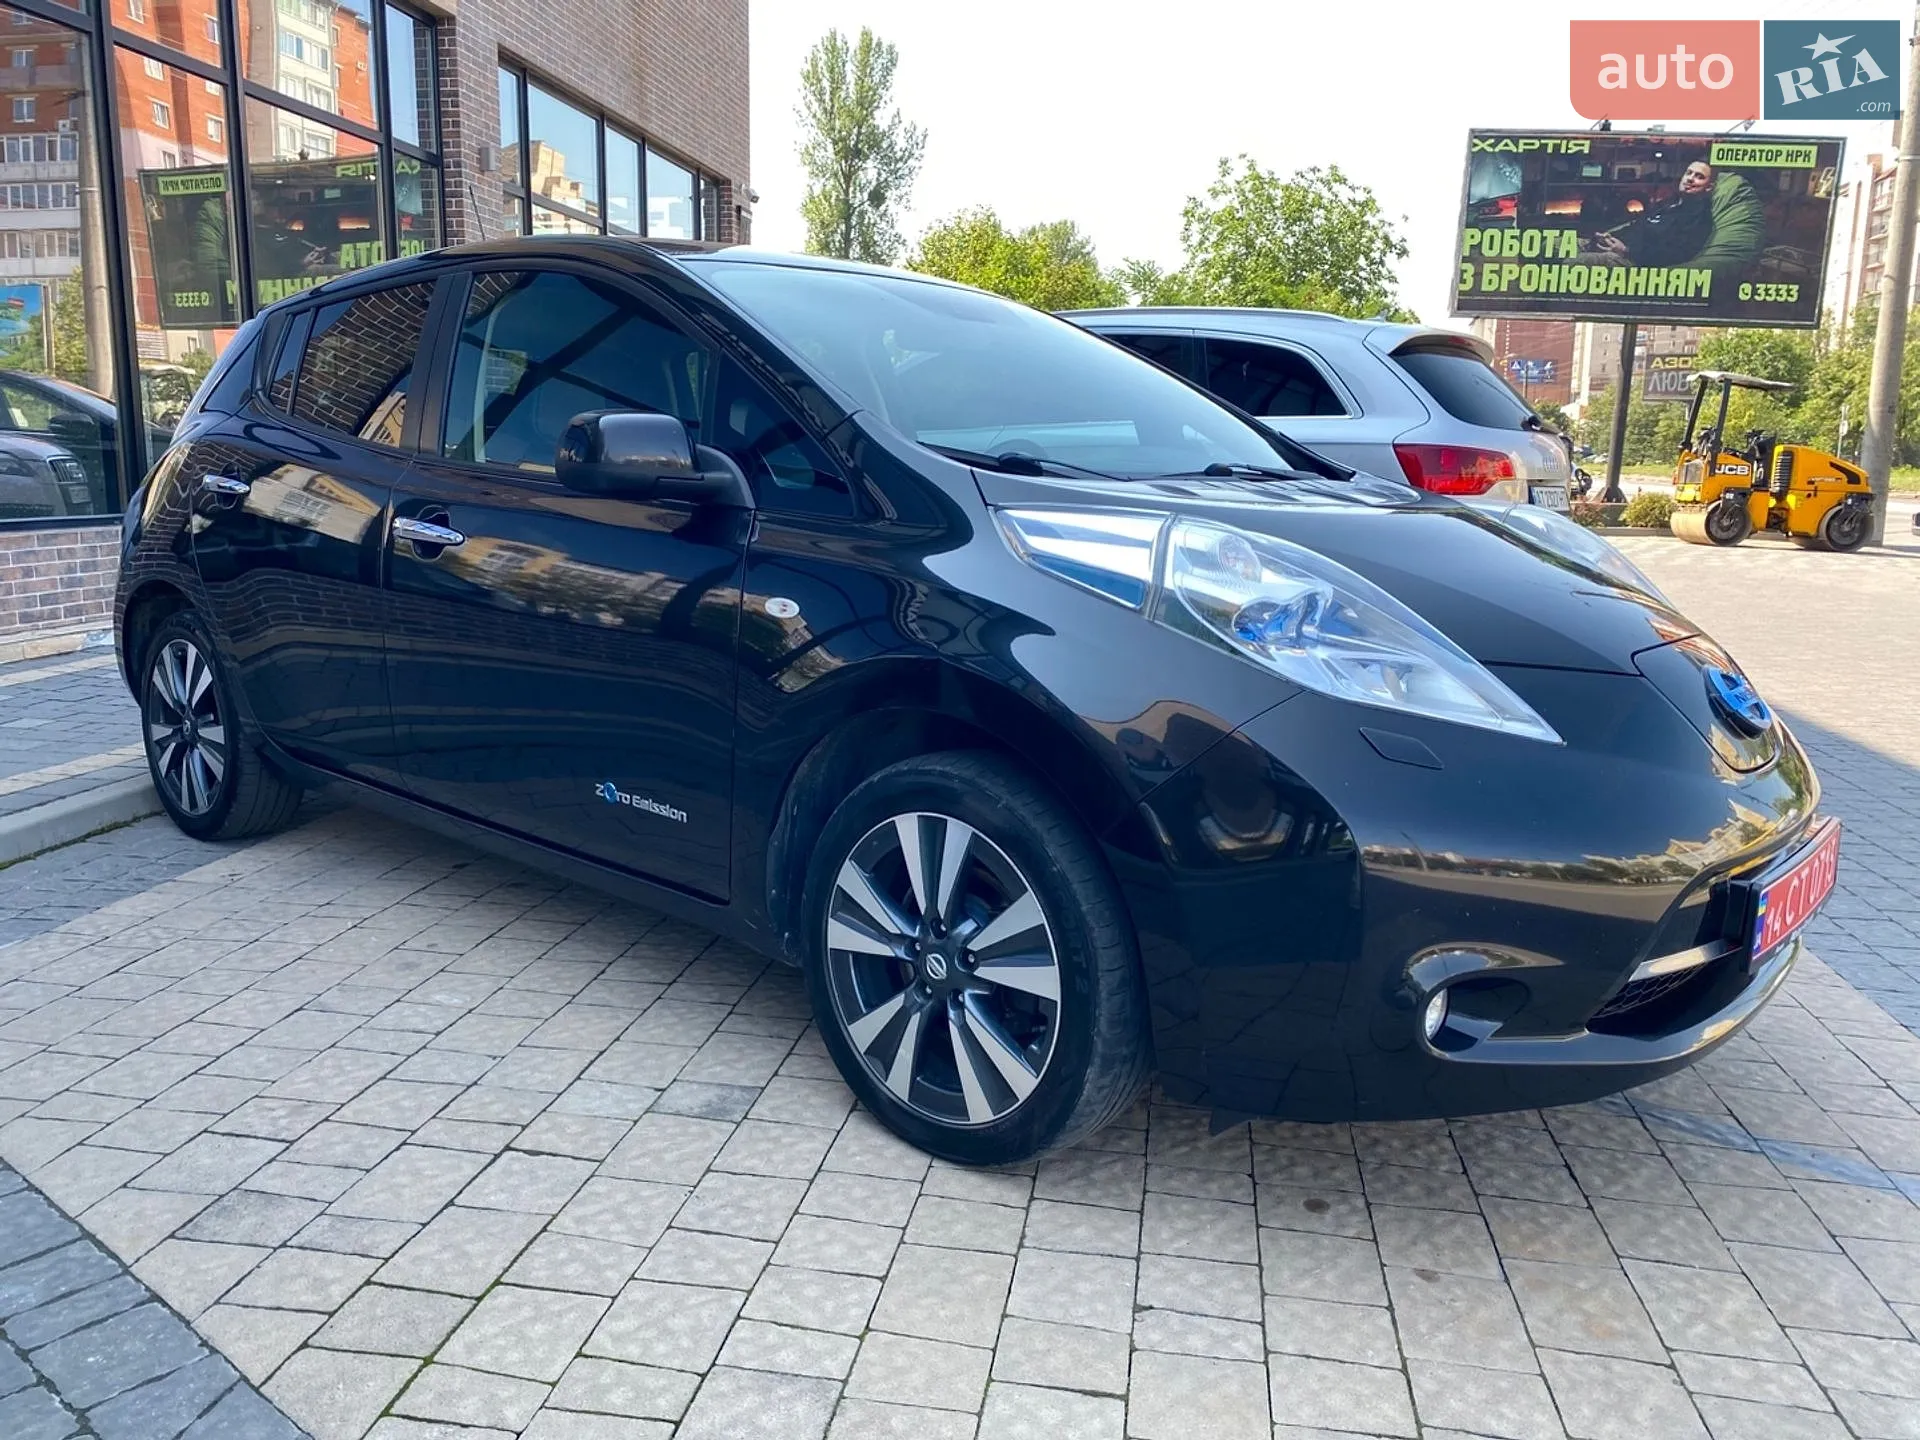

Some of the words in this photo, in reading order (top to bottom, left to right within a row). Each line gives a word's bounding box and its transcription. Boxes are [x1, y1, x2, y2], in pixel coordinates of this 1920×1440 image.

[1471, 138, 1591, 154] ХАРТІЯ
[1716, 147, 1783, 162] ОПЕРАТОР
[1786, 149, 1813, 163] НРК
[1462, 228, 1578, 259] РОБОТА
[1481, 262, 1713, 298] БРОНЮВАННЯМ
[1754, 283, 1800, 303] 3333
[1714, 464, 1750, 475] JCB
